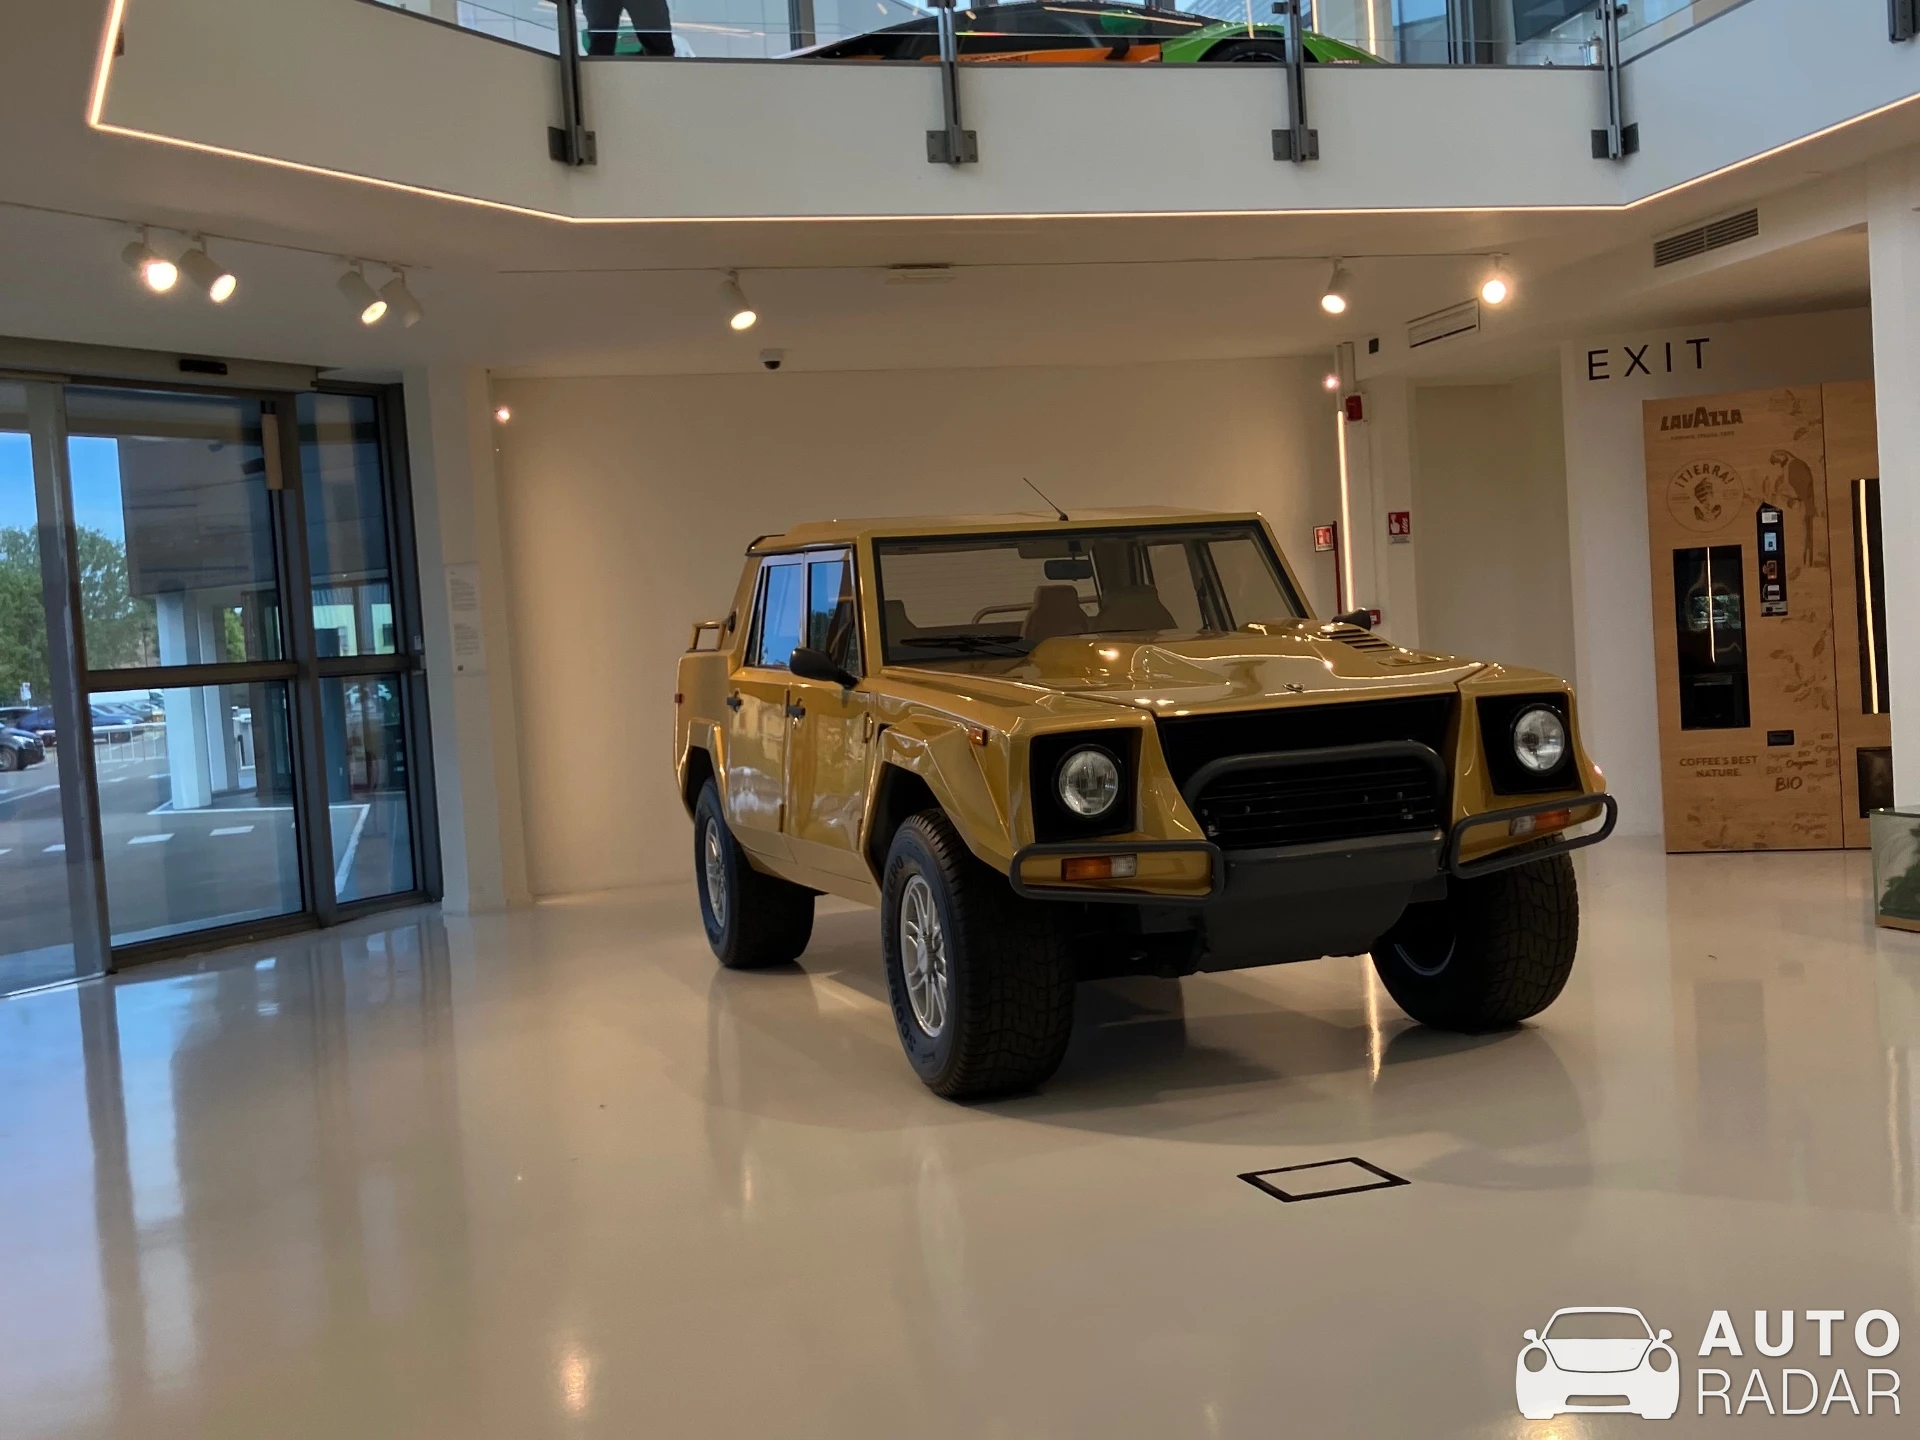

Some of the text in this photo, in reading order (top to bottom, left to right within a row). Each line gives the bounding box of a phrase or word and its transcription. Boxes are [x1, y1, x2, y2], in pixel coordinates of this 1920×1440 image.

[1588, 338, 1710, 380] EXIT
[1660, 406, 1743, 431] LAVAZZA
[1730, 755, 1758, 765] BEST
[1775, 776, 1803, 792] BIO
